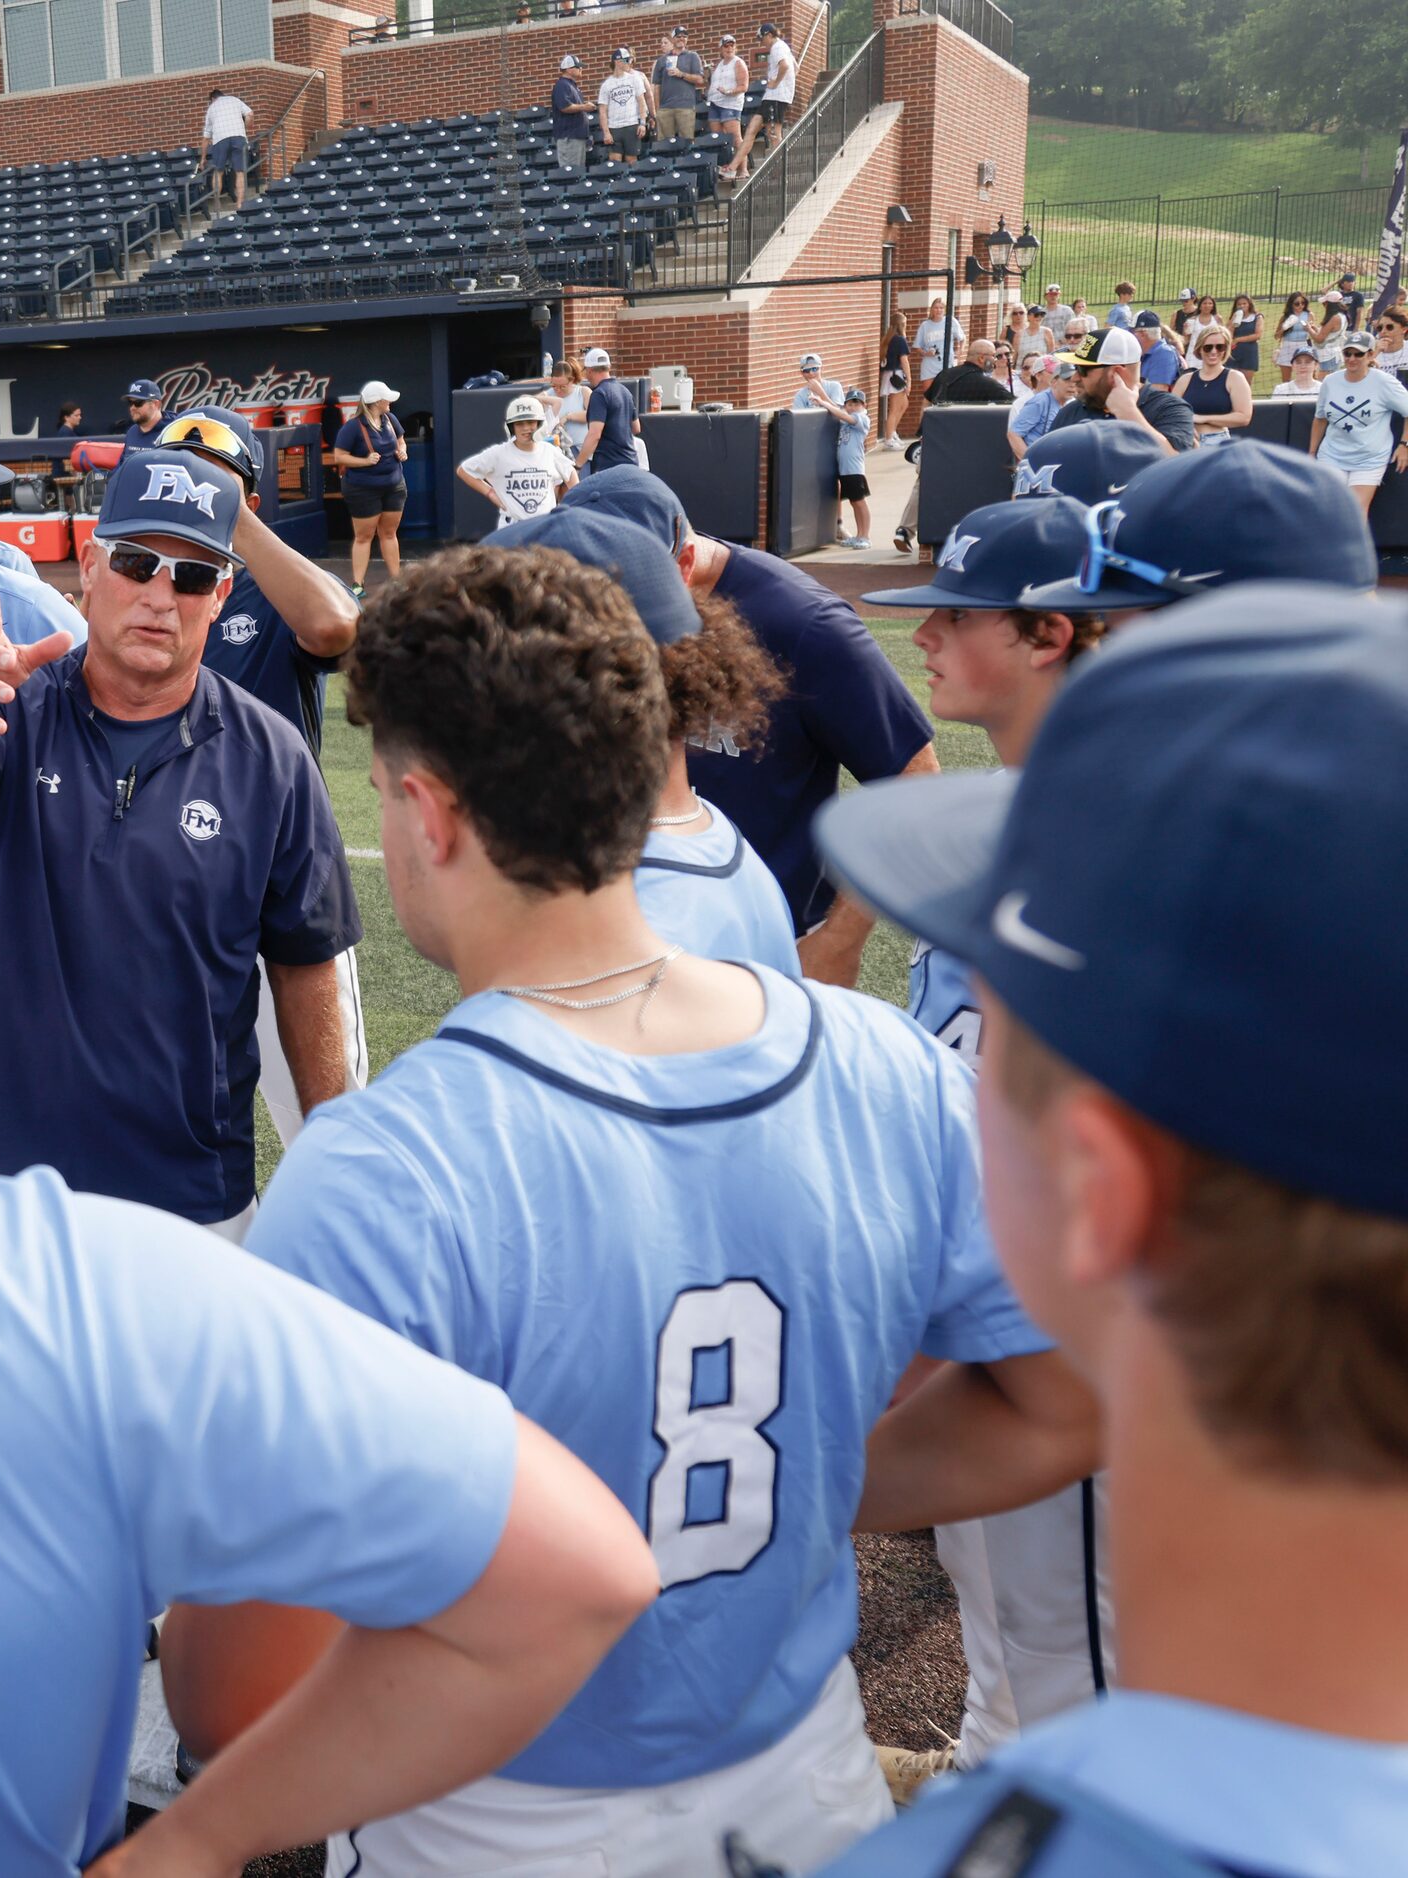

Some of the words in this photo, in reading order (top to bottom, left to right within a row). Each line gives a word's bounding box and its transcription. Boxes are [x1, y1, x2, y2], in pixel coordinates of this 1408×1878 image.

[155, 362, 331, 413] Patriots
[139, 463, 222, 521] FM
[18, 525, 36, 545] G
[226, 623, 254, 638] FM
[184, 807, 218, 833] FM
[644, 1276, 789, 1593] 8
